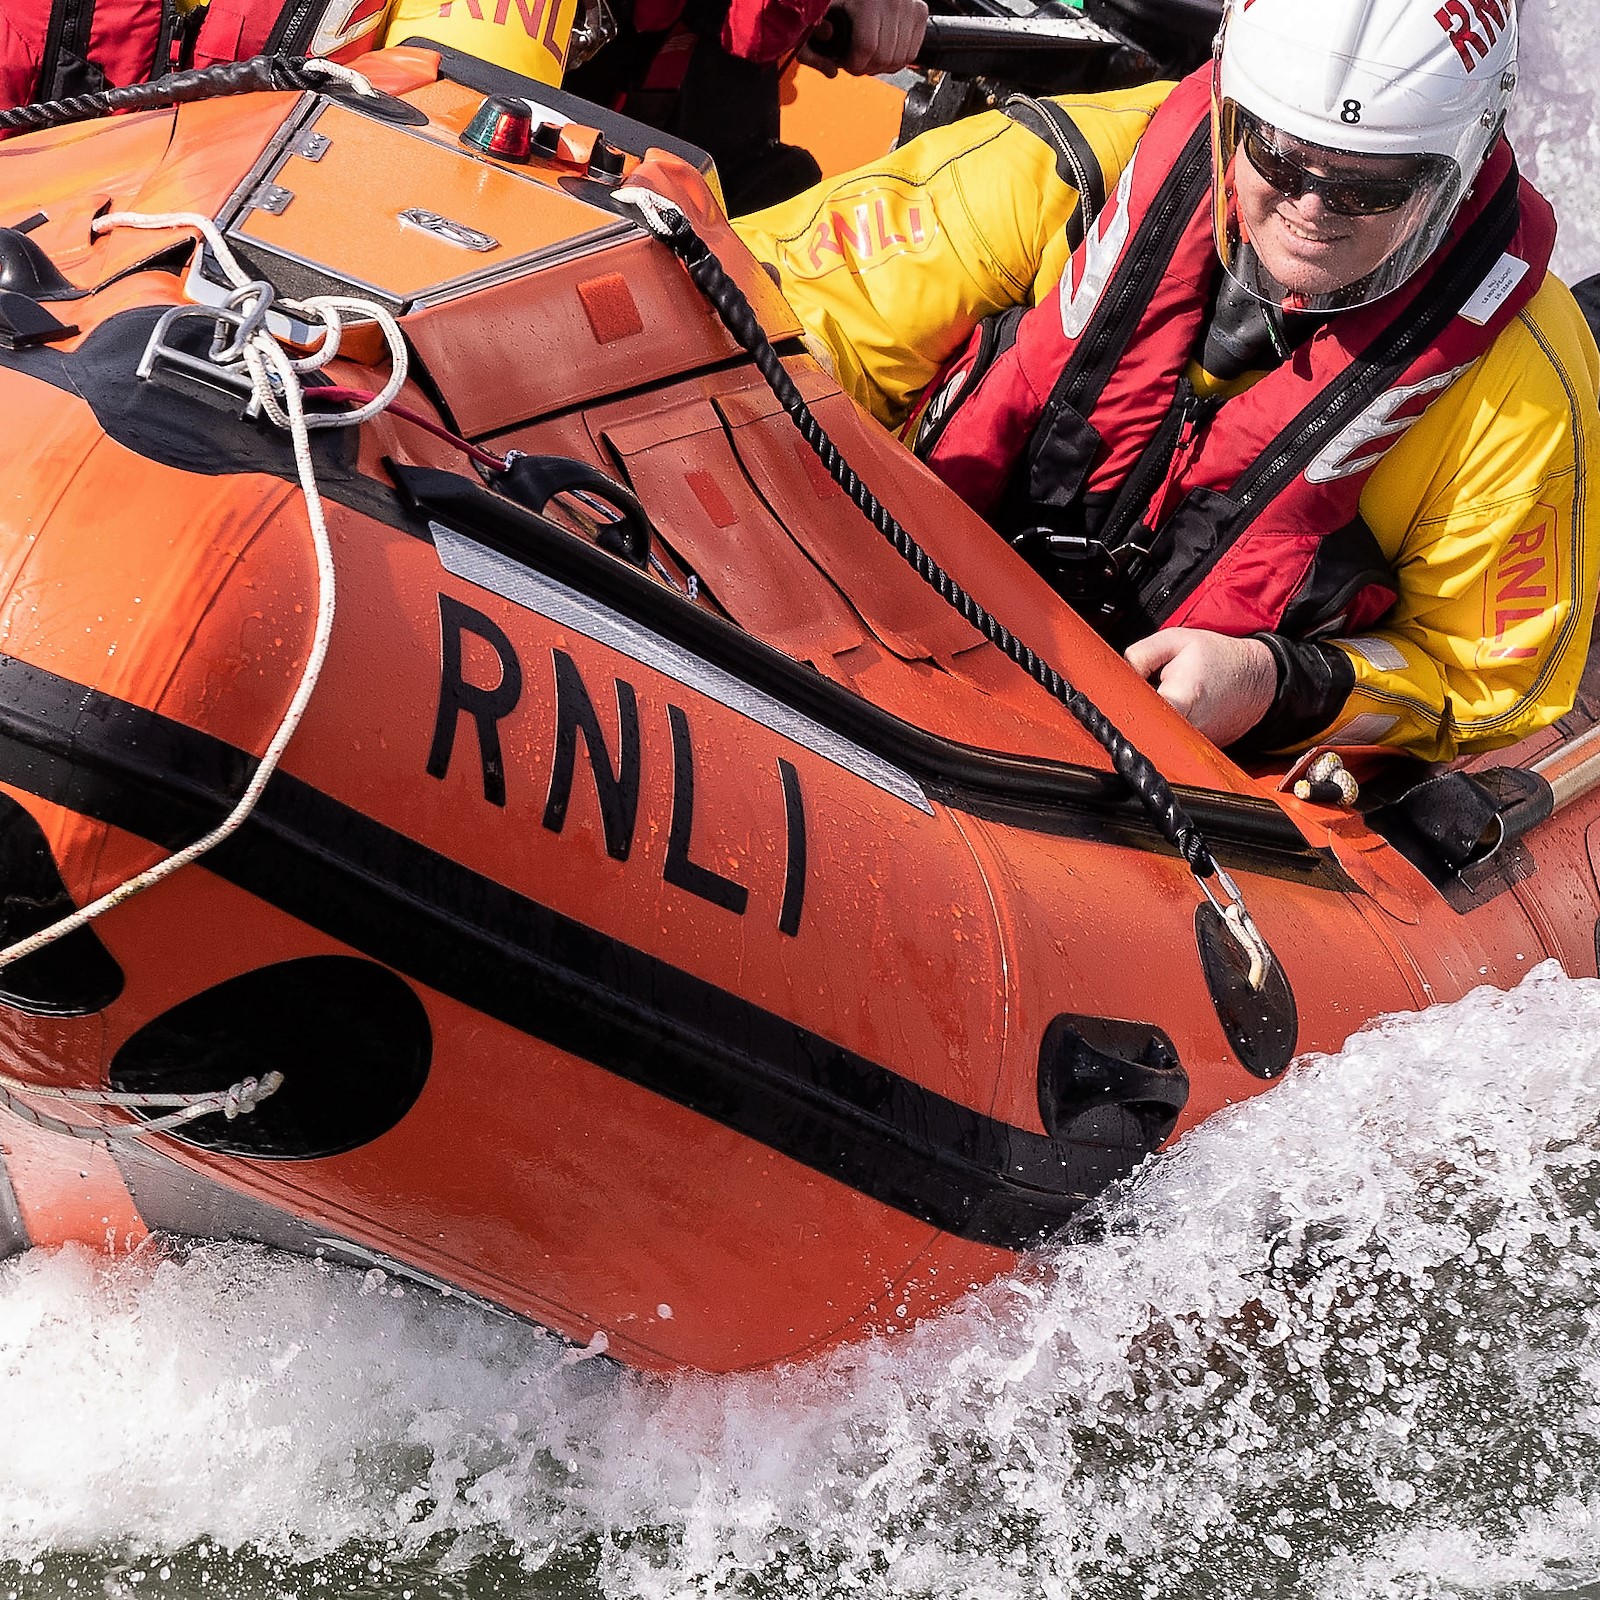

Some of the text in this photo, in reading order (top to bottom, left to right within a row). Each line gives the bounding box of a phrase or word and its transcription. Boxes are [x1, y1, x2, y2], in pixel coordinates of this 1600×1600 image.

[1340, 99, 1362, 125] 8
[808, 199, 924, 271] RNLI
[1489, 521, 1547, 658] RNLI
[426, 591, 807, 938] RNLI
